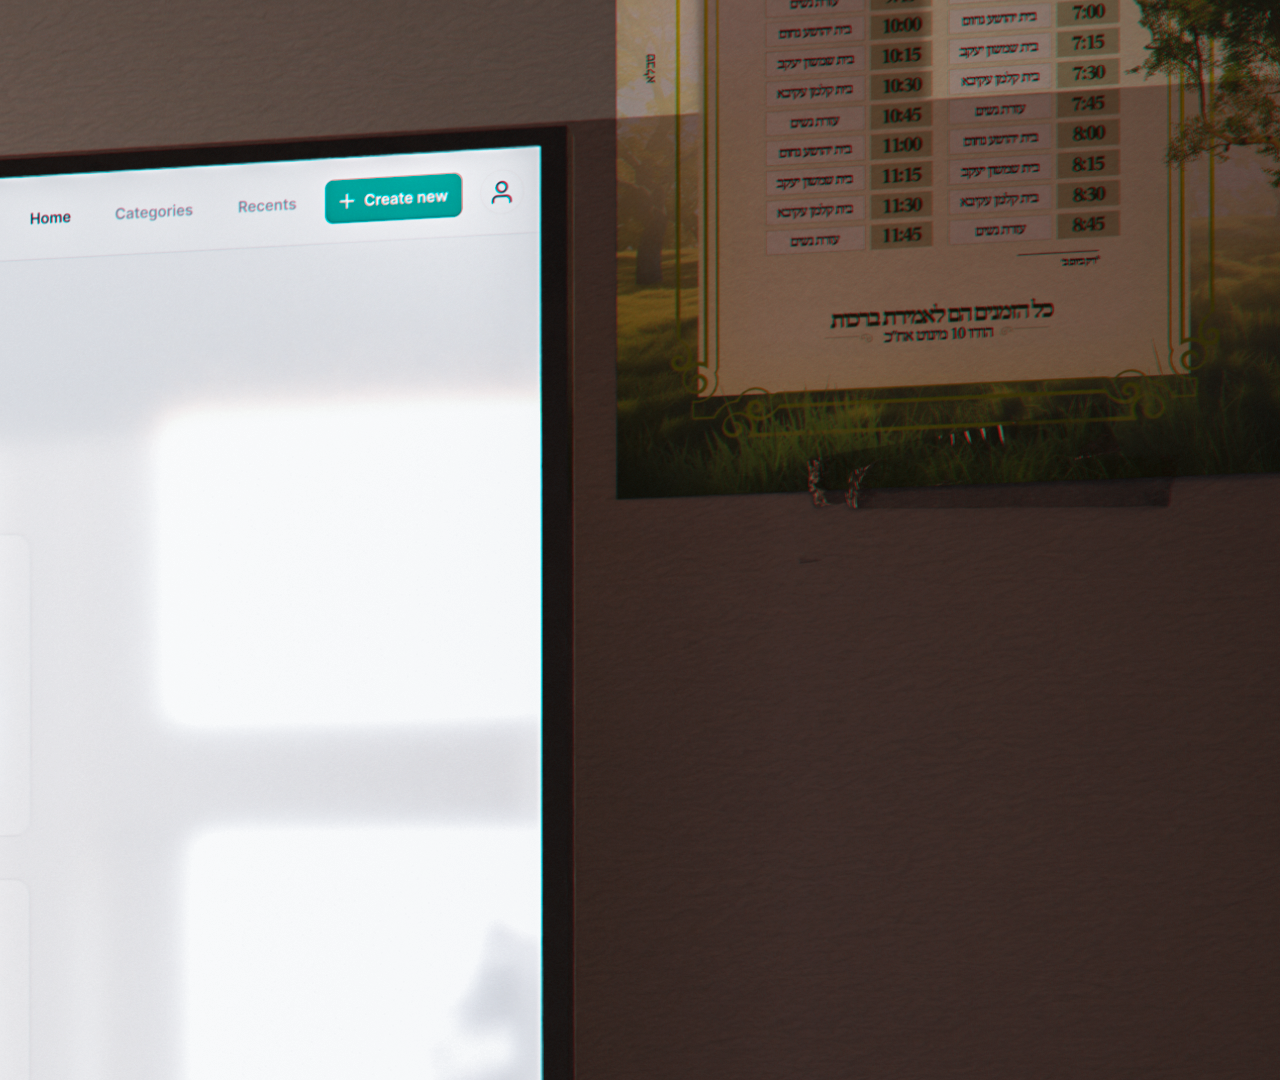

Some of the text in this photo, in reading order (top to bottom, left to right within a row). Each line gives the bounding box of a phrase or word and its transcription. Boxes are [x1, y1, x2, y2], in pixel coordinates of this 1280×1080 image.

[961, 3, 1106, 27] 7:00 בית יהושע נחום
[778, 16, 923, 39] 10:00 בית יהושע נחום
[959, 34, 1105, 58] 7:15 בית שמשון יעקב
[776, 46, 922, 71] 10:15 בית שמשון יעקב
[643, 54, 656, 84] טבלא
[961, 65, 1106, 88] 7:30 בית קלמן עקיבא
[974, 106, 1000, 117] נשים
[1071, 95, 1105, 111] 7:45
[237, 198, 297, 214] Recents
[364, 190, 449, 208] Create new
[30, 210, 71, 226] Home
[114, 203, 193, 222] Categories
[830, 298, 1055, 329] כל הזמנים הם לאמירת ברכות
[883, 330, 914, 343] אח"כ
[915, 329, 948, 341] מינוט
[952, 326, 966, 340] 10
